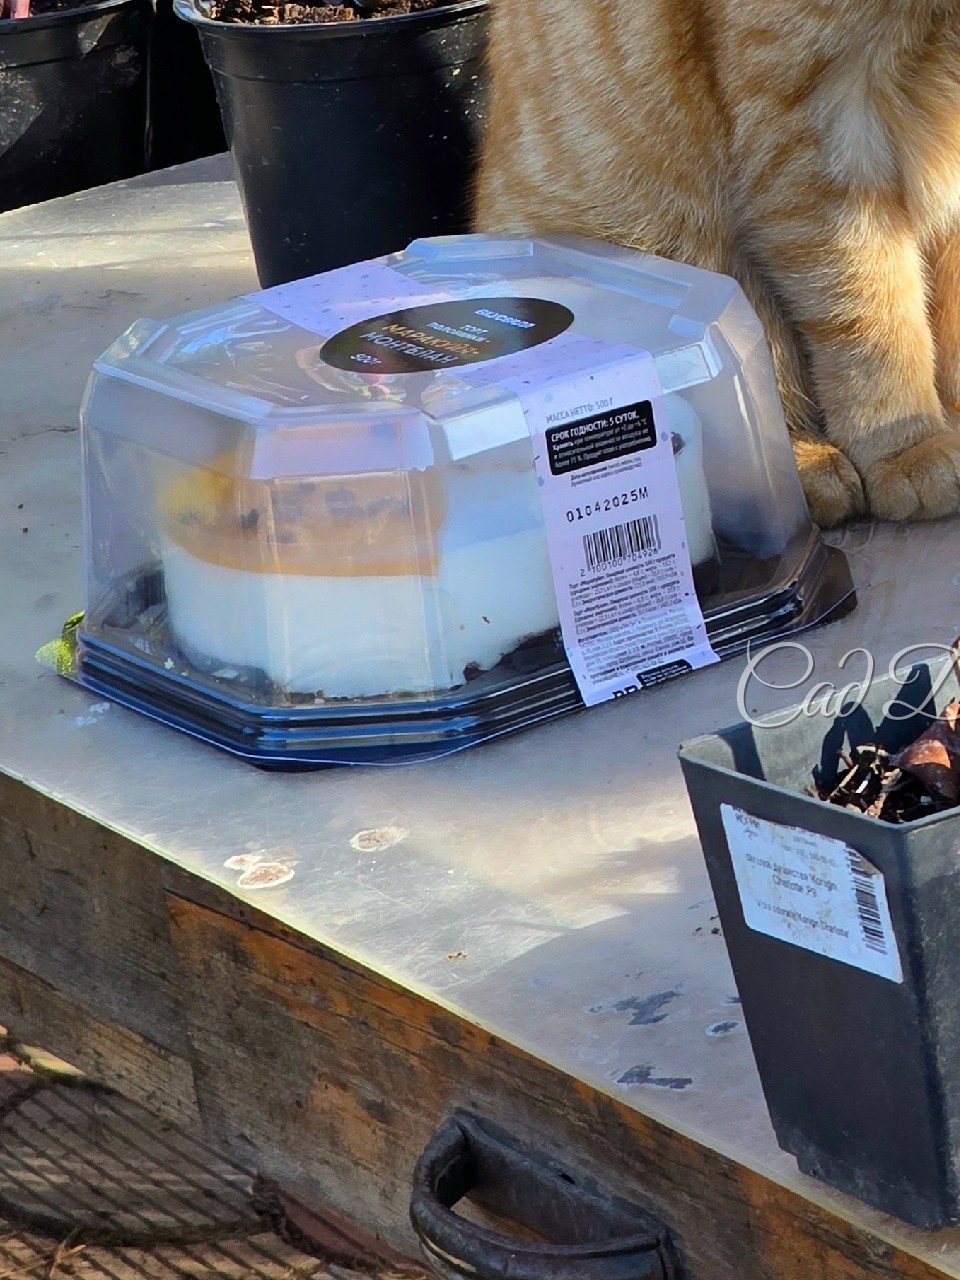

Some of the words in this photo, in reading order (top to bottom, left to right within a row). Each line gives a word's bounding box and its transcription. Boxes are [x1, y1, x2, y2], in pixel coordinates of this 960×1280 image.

[360, 331, 458, 364] МОНТБЛАН
[545, 410, 570, 424] МАССА
[551, 430, 569, 443] СРОК
[570, 418, 609, 438] ГОДНОСТИ:
[615, 410, 640, 424] СУТОК.
